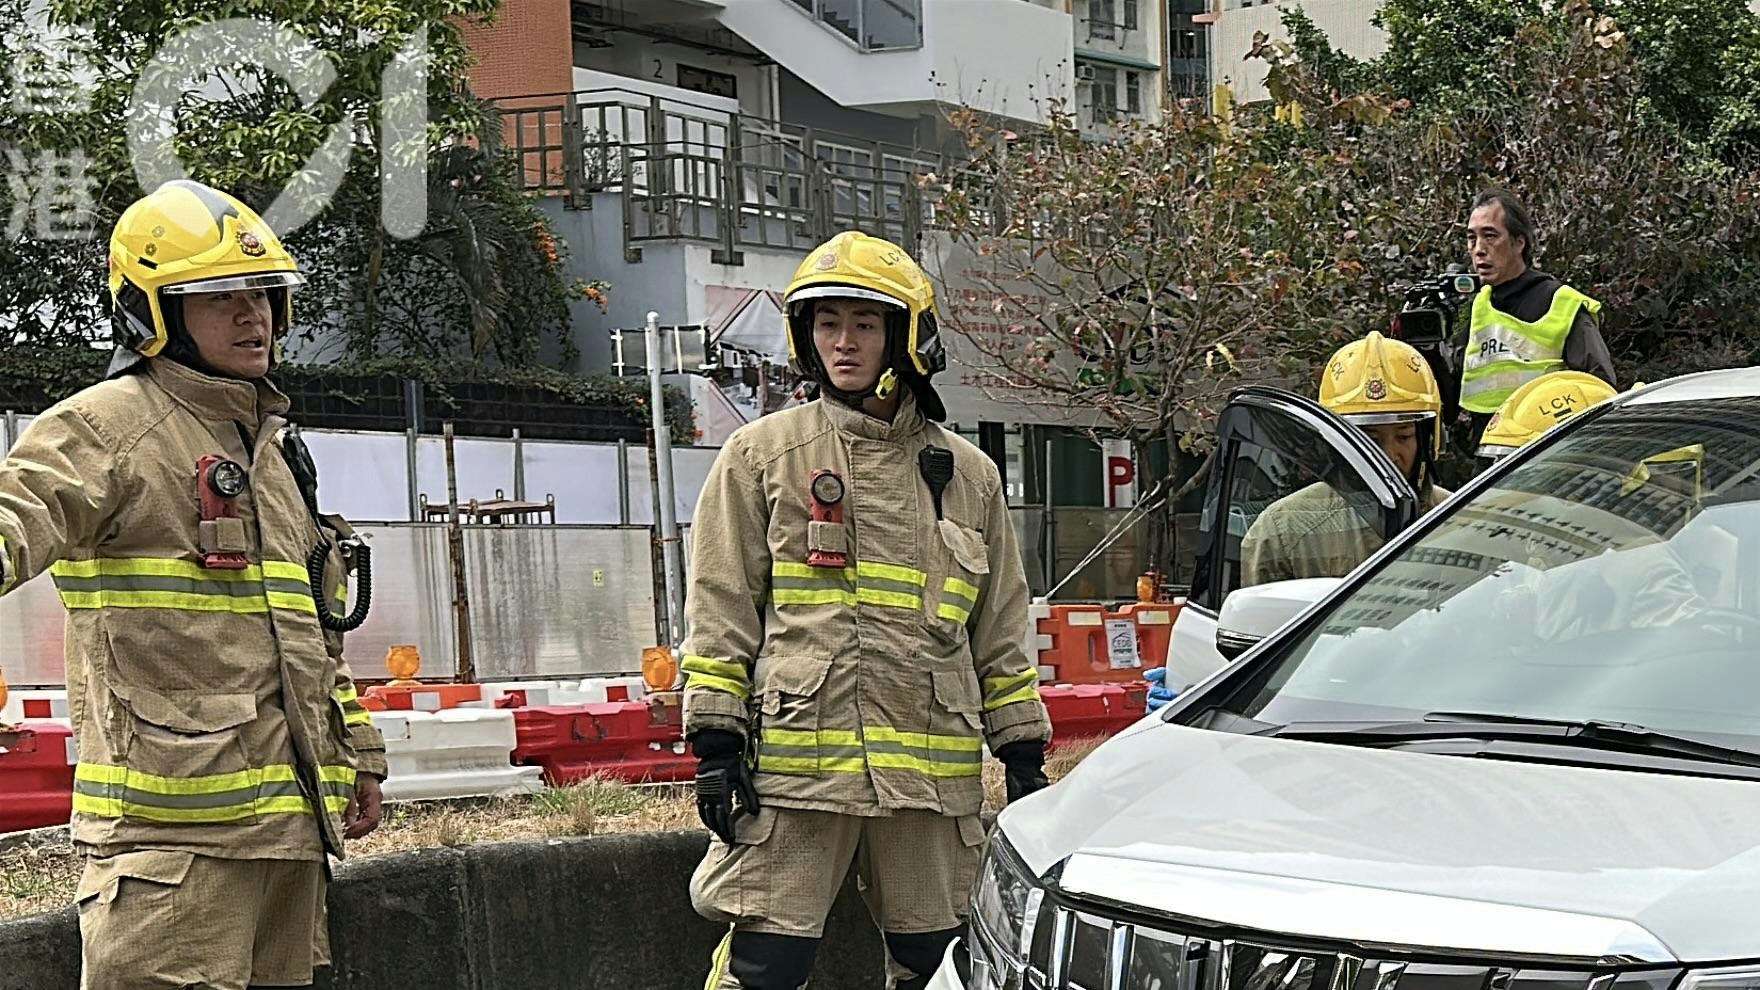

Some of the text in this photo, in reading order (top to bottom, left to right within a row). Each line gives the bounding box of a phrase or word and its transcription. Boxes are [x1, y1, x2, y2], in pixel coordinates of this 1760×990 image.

[653, 59, 663, 78] 2
[1539, 393, 1576, 416] LCK
[1108, 456, 1134, 509] P
